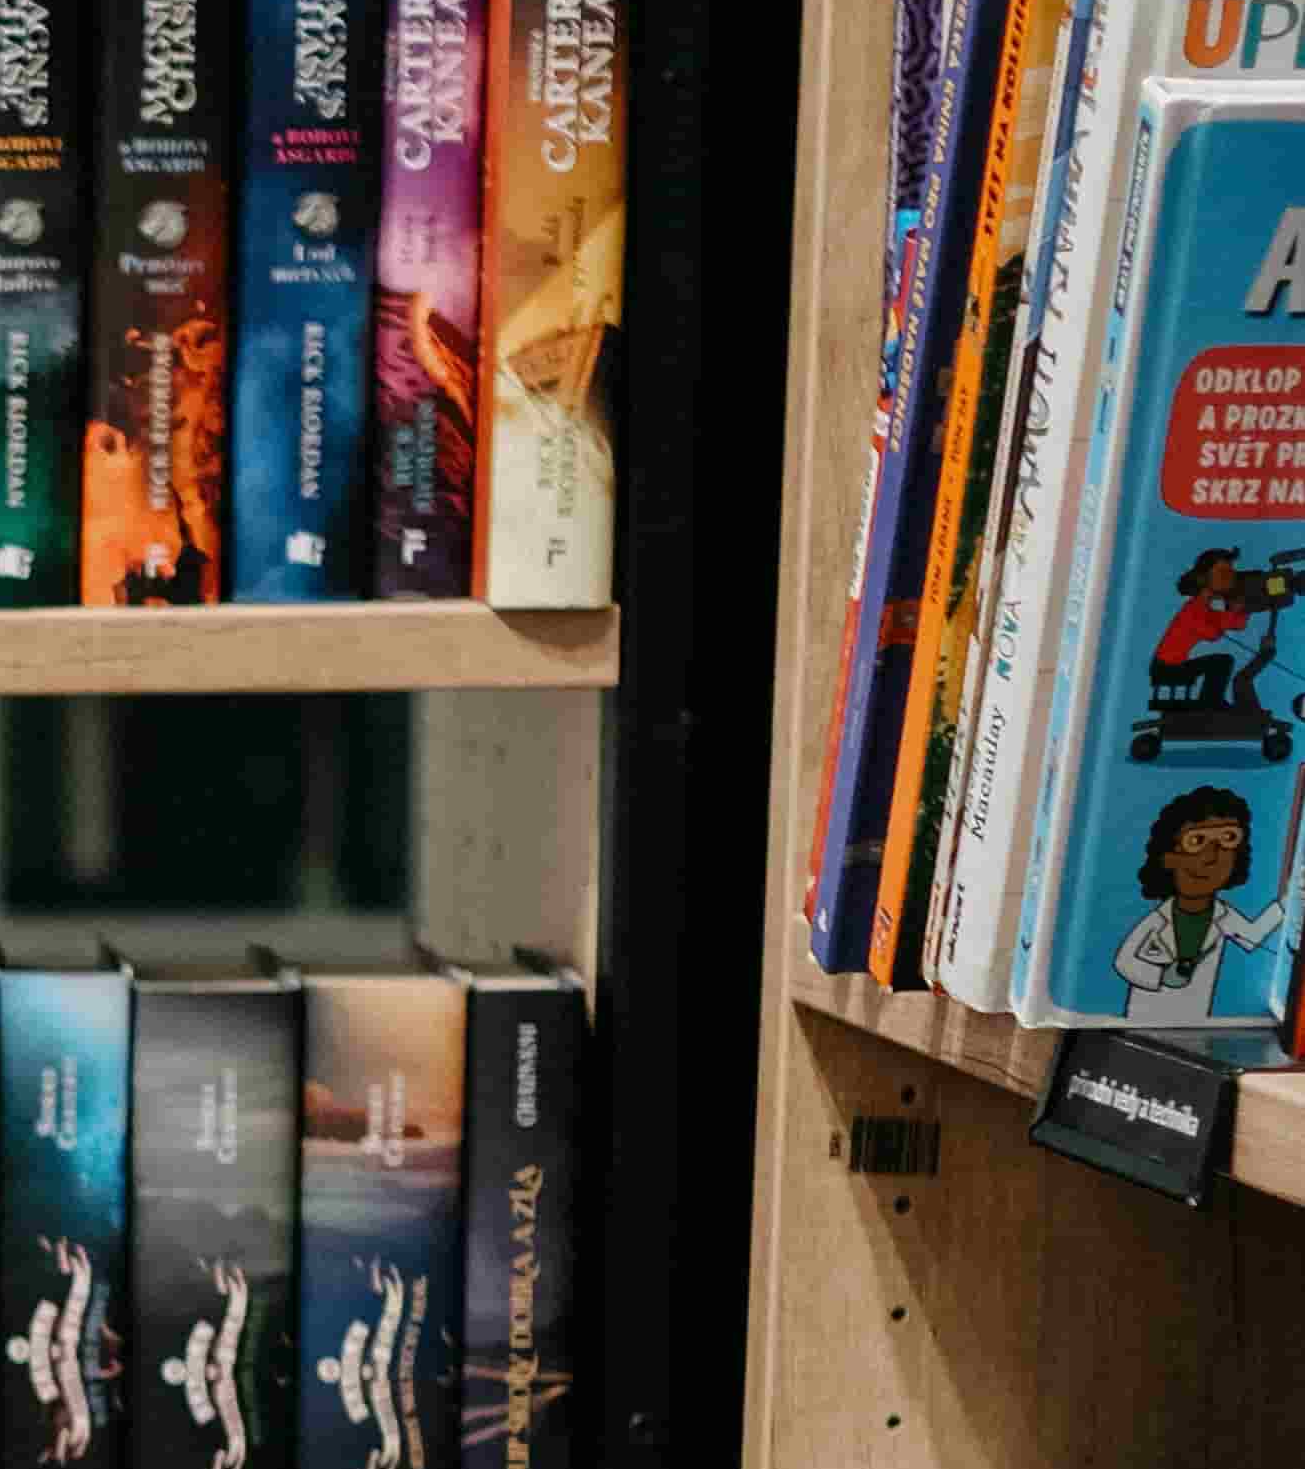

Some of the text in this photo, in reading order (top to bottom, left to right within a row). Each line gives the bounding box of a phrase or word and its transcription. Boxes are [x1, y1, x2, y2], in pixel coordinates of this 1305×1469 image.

[921, 79, 959, 230] KNIHA PRO
[6, 333, 30, 509] RICK RIORDAN
[299, 322, 326, 500] RICK RIORDAN
[1195, 367, 1301, 396] ODKLOP
[1197, 405, 1216, 431] A
[1191, 477, 1260, 505] SKRZ
[1198, 435, 1265, 470] SVĚT
[969, 706, 1008, 843] Macaulay
